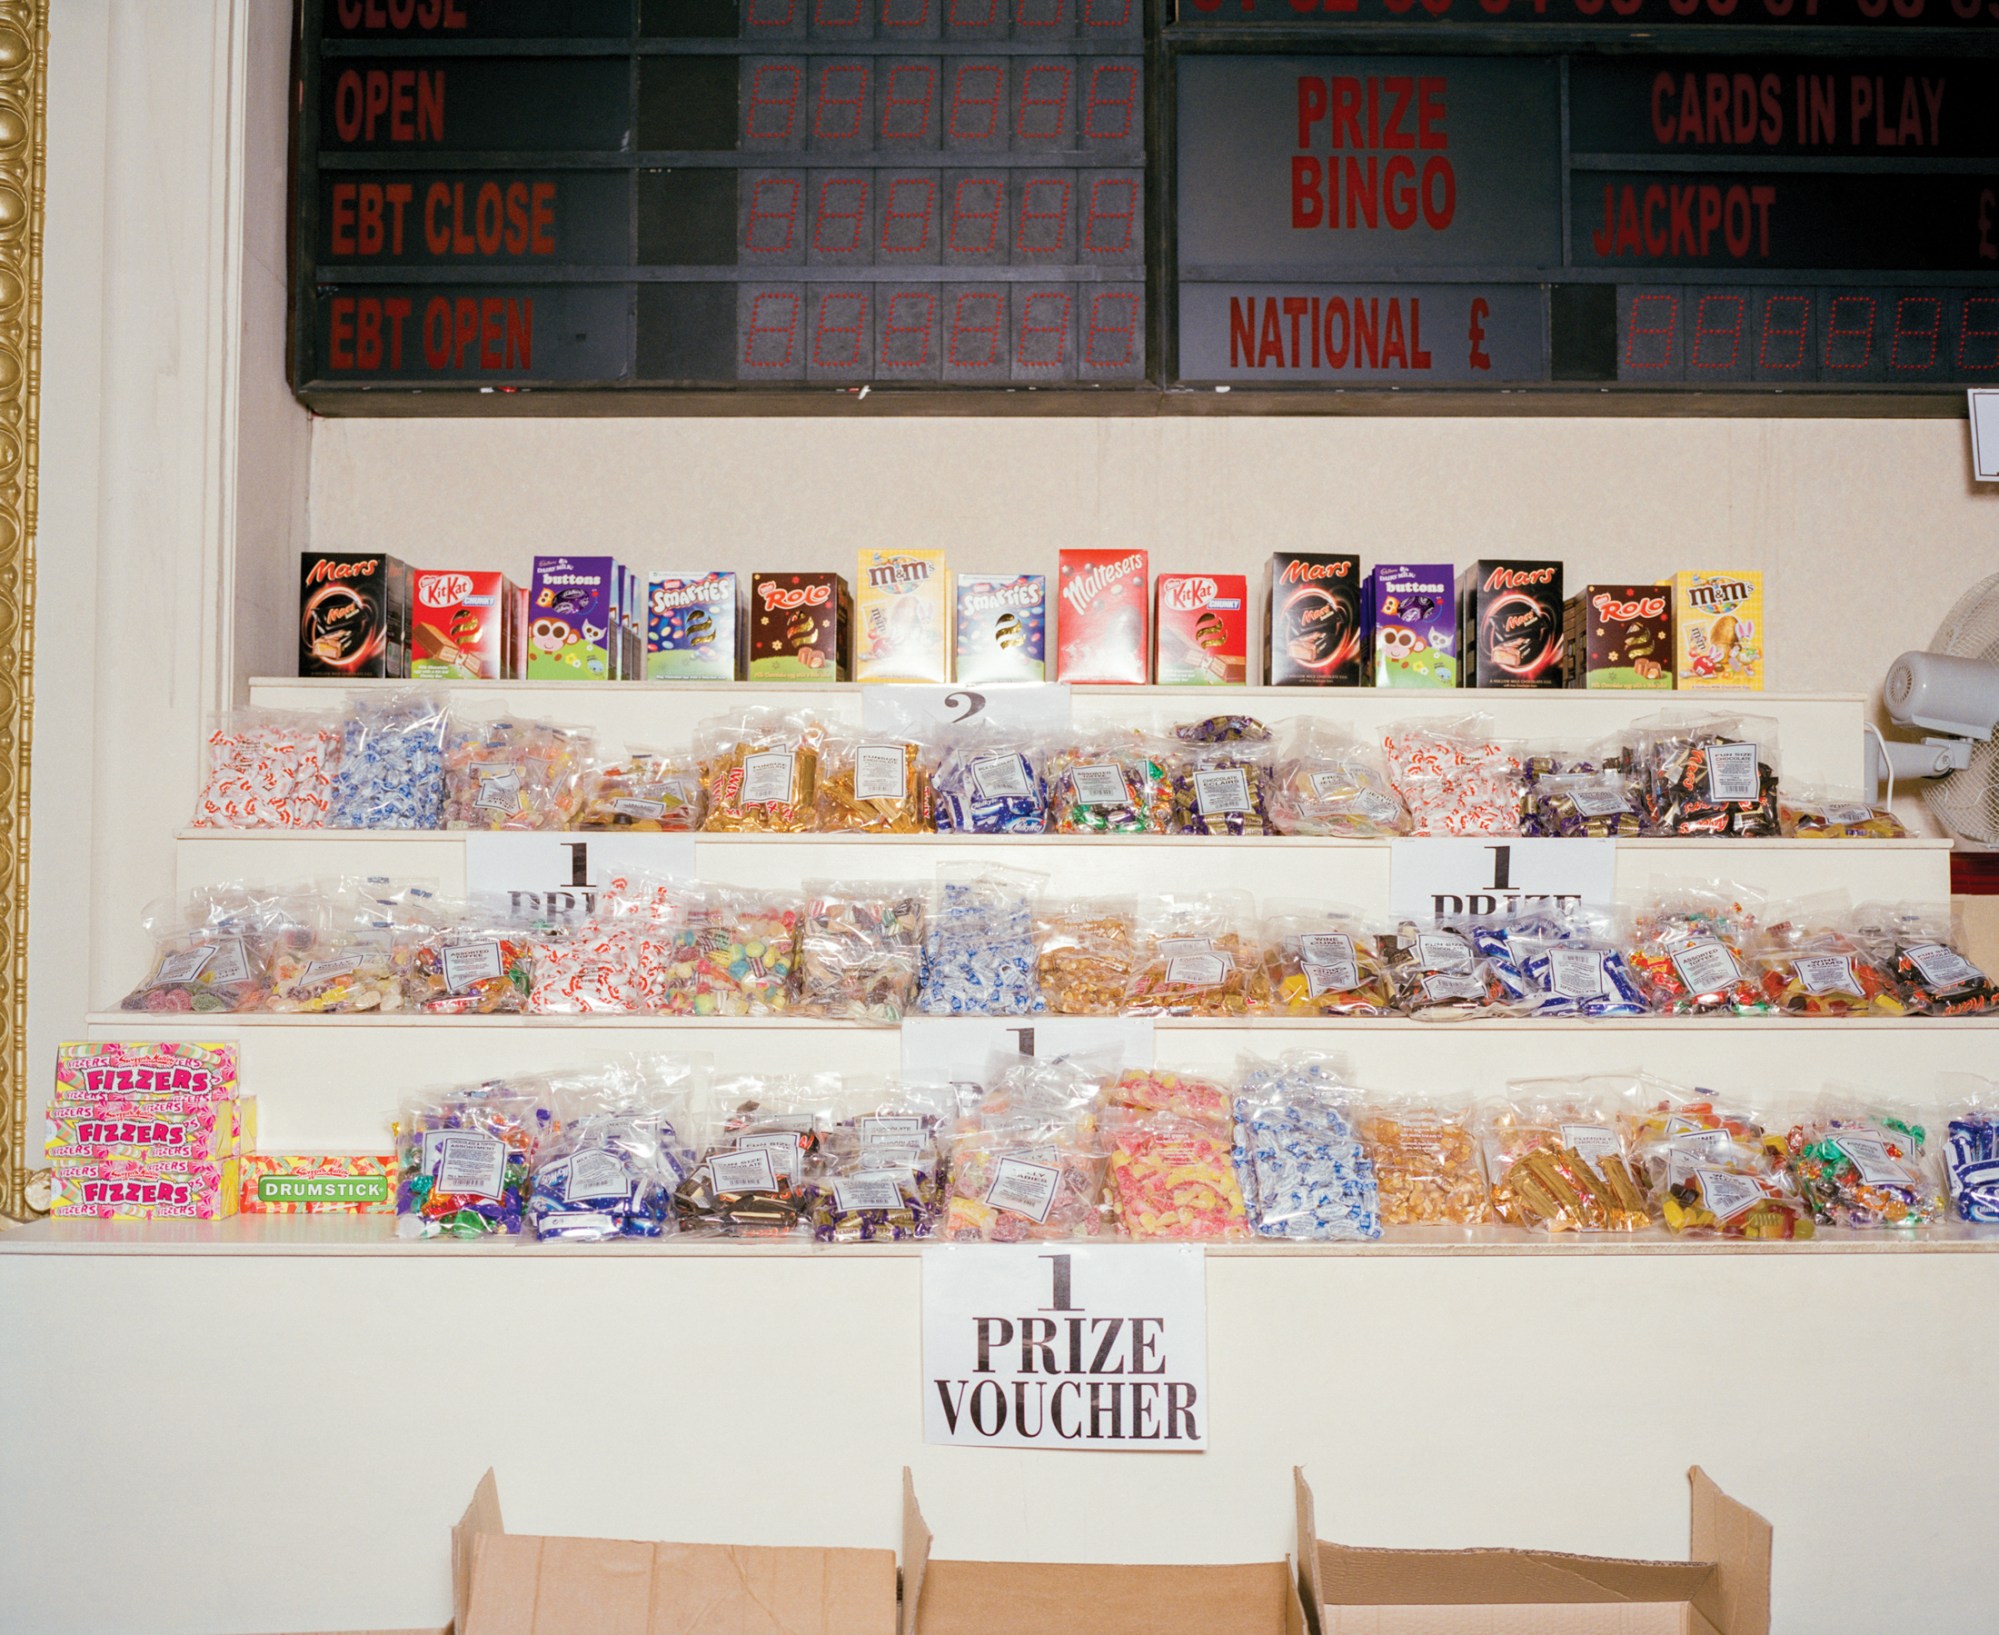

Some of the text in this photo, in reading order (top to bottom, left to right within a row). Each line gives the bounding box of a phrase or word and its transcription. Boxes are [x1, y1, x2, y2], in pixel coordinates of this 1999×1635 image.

[336, 69, 445, 143] OPEN
[1297, 75, 1448, 149] PRIZE
[1651, 72, 1946, 146] CARDS IN PLAY
[1291, 154, 1456, 231] BINGO
[332, 181, 557, 256] EBT CLOSE
[1592, 184, 1776, 258] JACKPOT
[330, 295, 534, 371] EBT OPEN
[1230, 296, 1491, 370] NATIONAL £
[306, 559, 378, 585] Mars
[543, 574, 601, 585] buttons
[1063, 554, 1143, 615] Maltesers
[1280, 560, 1351, 585] Mars
[1386, 582, 1444, 593] buttons
[1484, 567, 1555, 591] Mars
[944, 691, 986, 724] 2
[560, 842, 597, 887] 1
[1483, 845, 1520, 890] 1
[86, 1068, 208, 1092] FIZZERS
[78, 1122, 184, 1145] FIZZERS
[84, 1182, 189, 1205] FIZZERS
[265, 1183, 380, 1196] DRUMSTICK
[1038, 1254, 1085, 1311] 1
[972, 1316, 1166, 1375] PRIZE
[934, 1379, 1201, 1440] VOUCHER
